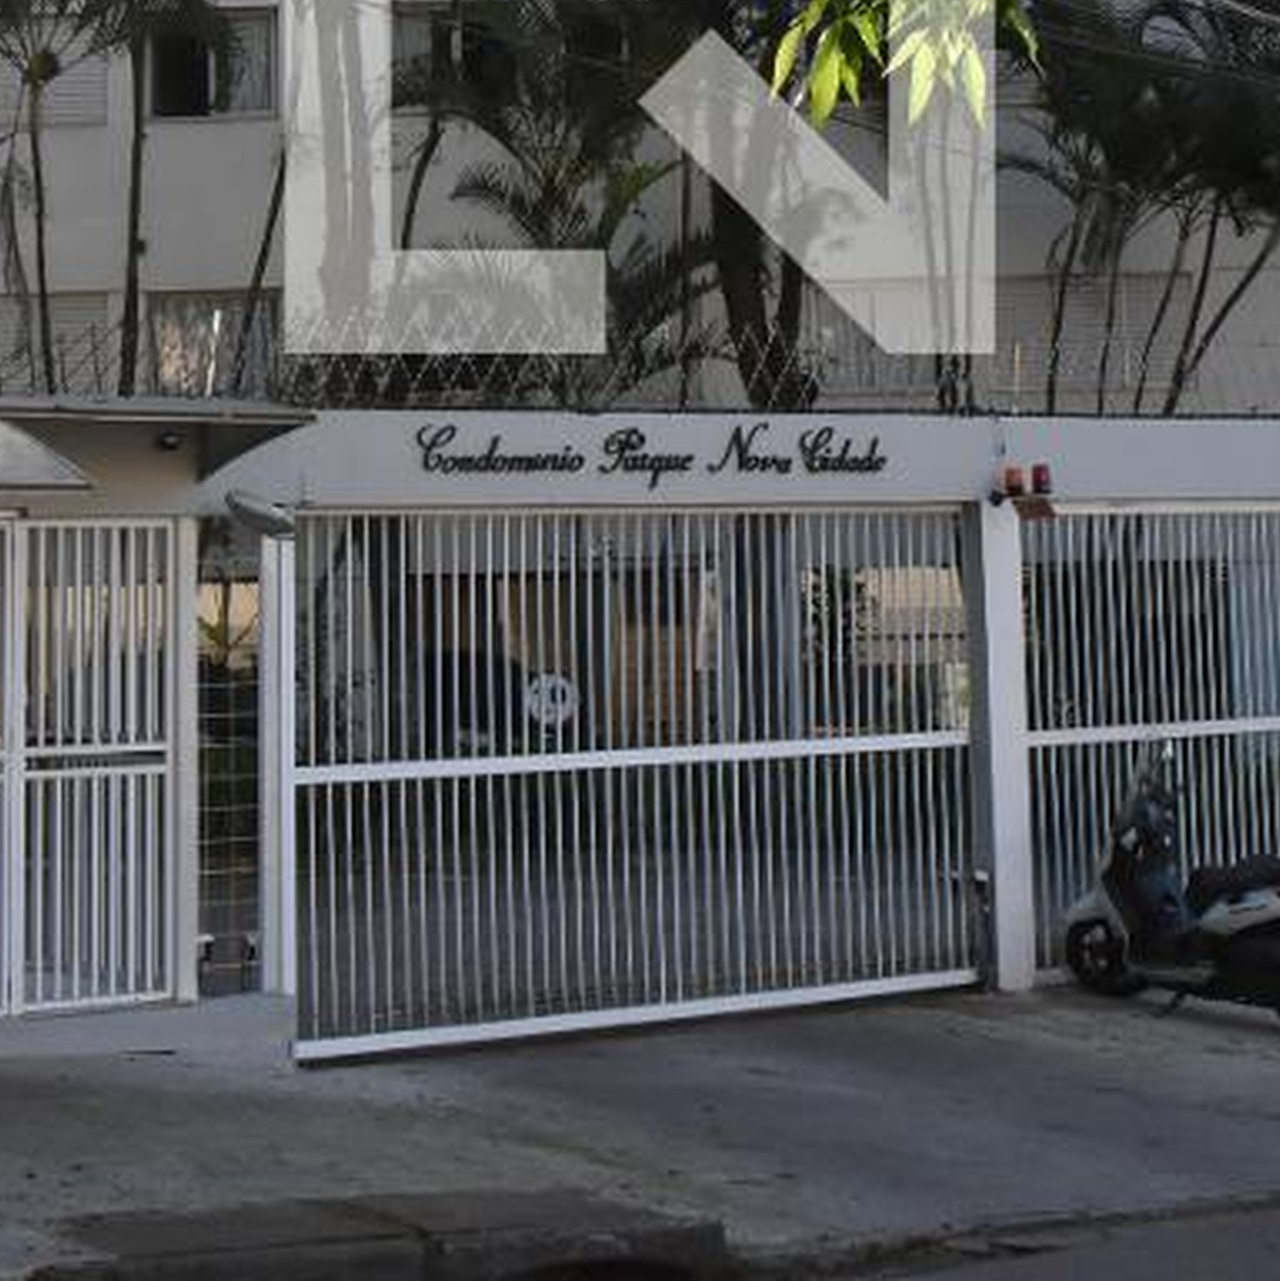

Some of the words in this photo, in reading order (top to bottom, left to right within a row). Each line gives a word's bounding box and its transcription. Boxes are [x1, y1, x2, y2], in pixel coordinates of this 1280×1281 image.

[598, 427, 695, 491] Parque
[706, 421, 793, 474] Nova
[798, 426, 888, 475] Cidade
